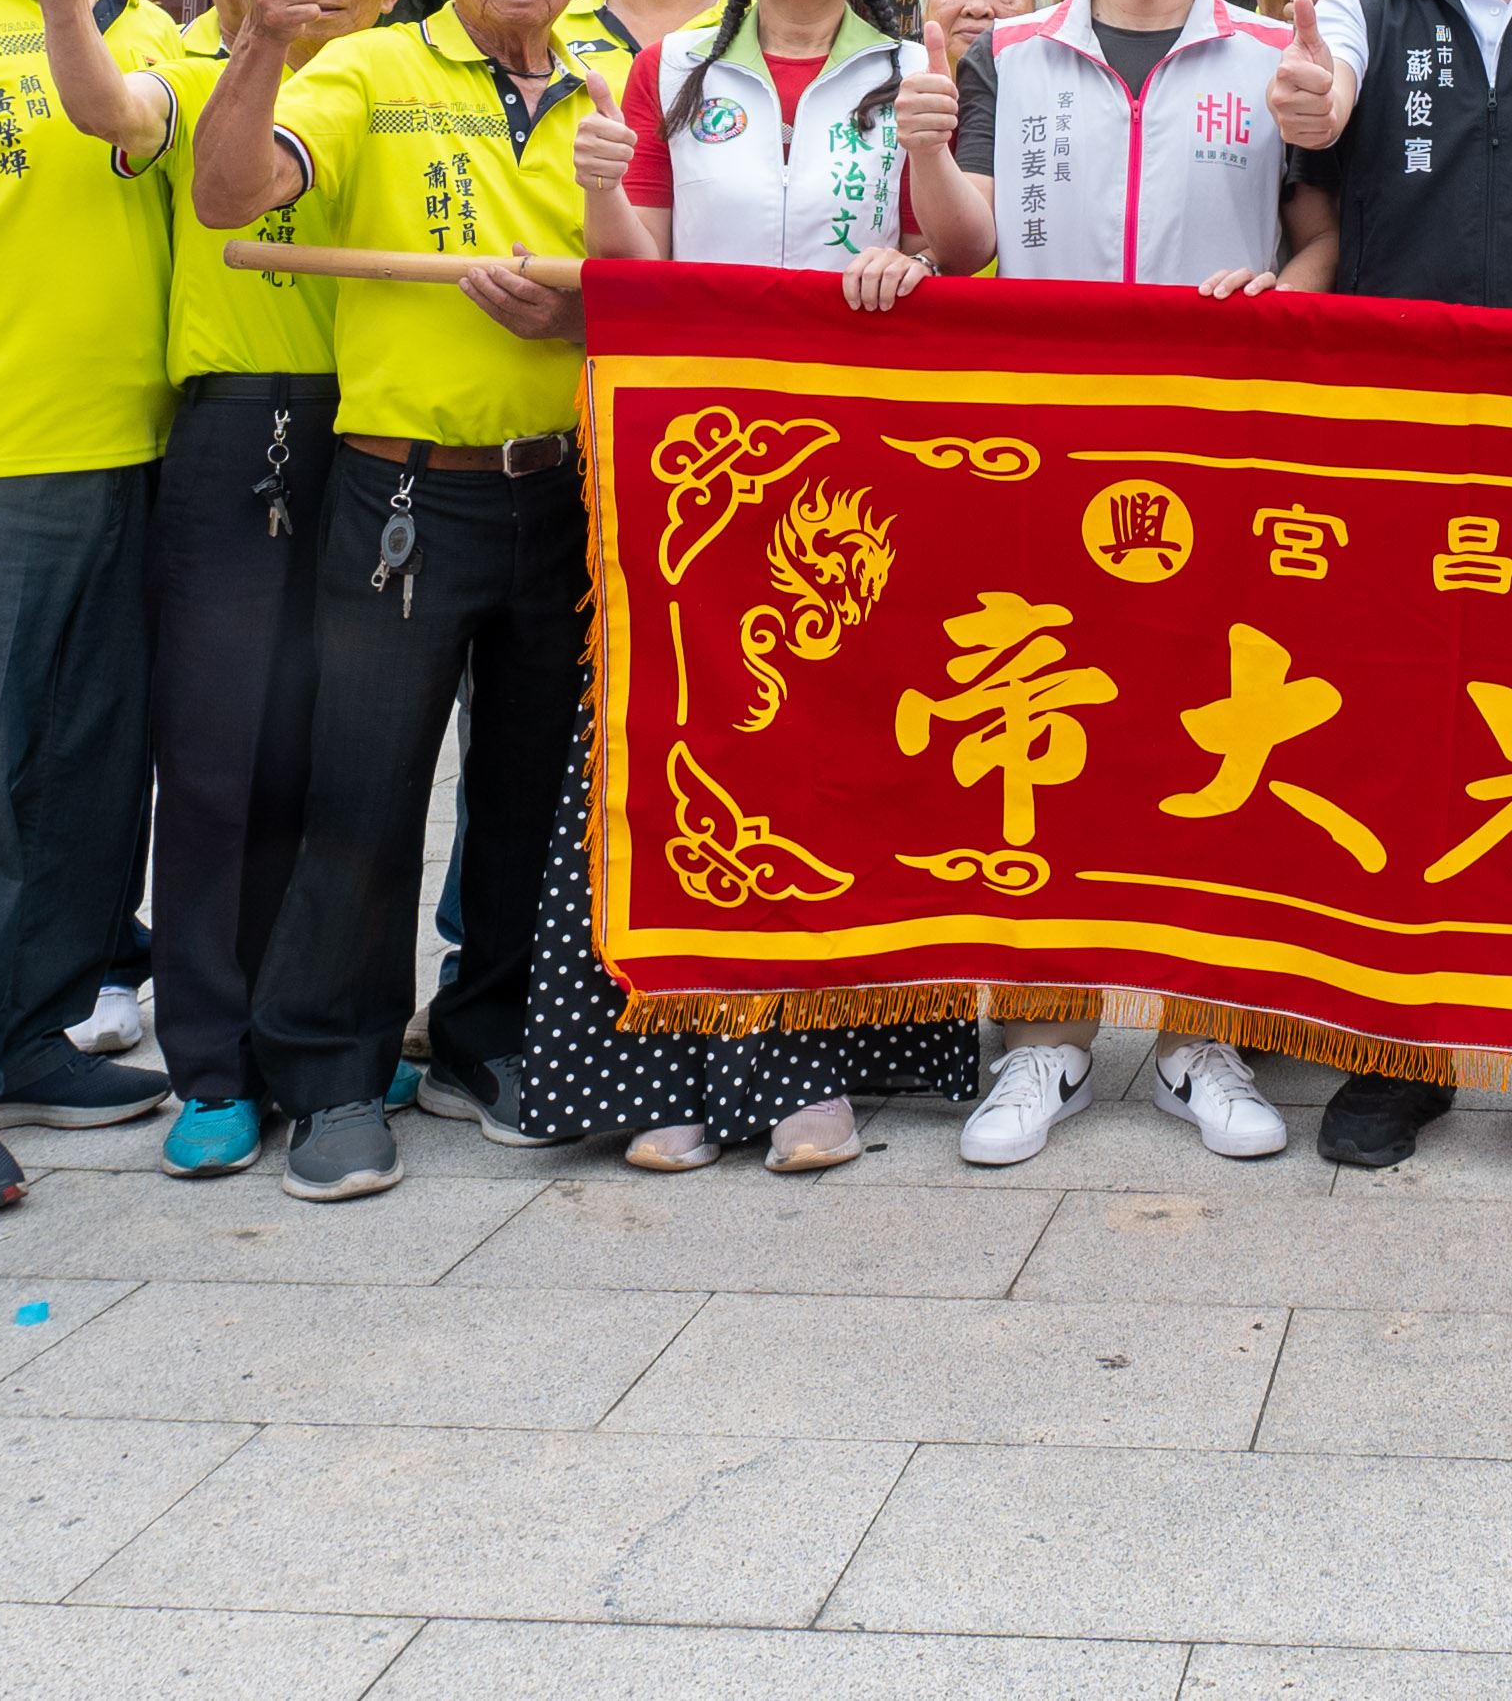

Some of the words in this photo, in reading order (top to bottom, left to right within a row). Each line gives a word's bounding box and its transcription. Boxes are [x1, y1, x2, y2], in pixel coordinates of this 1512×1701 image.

[20, 74, 52, 119] 顧問
[1434, 24, 1455, 89] 副市長
[1052, 90, 1075, 183] 客家局長
[1194, 149, 1249, 167] 桃園市政府
[1404, 48, 1434, 175] 蘇俊賓
[423, 160, 452, 252] 蕭財丁
[452, 153, 478, 247] 管理委員
[823, 116, 875, 255] 陳治文
[871, 103, 899, 234] 桃園市議員
[1020, 114, 1048, 248] 范姜泰基
[1105, 489, 1182, 572] 興
